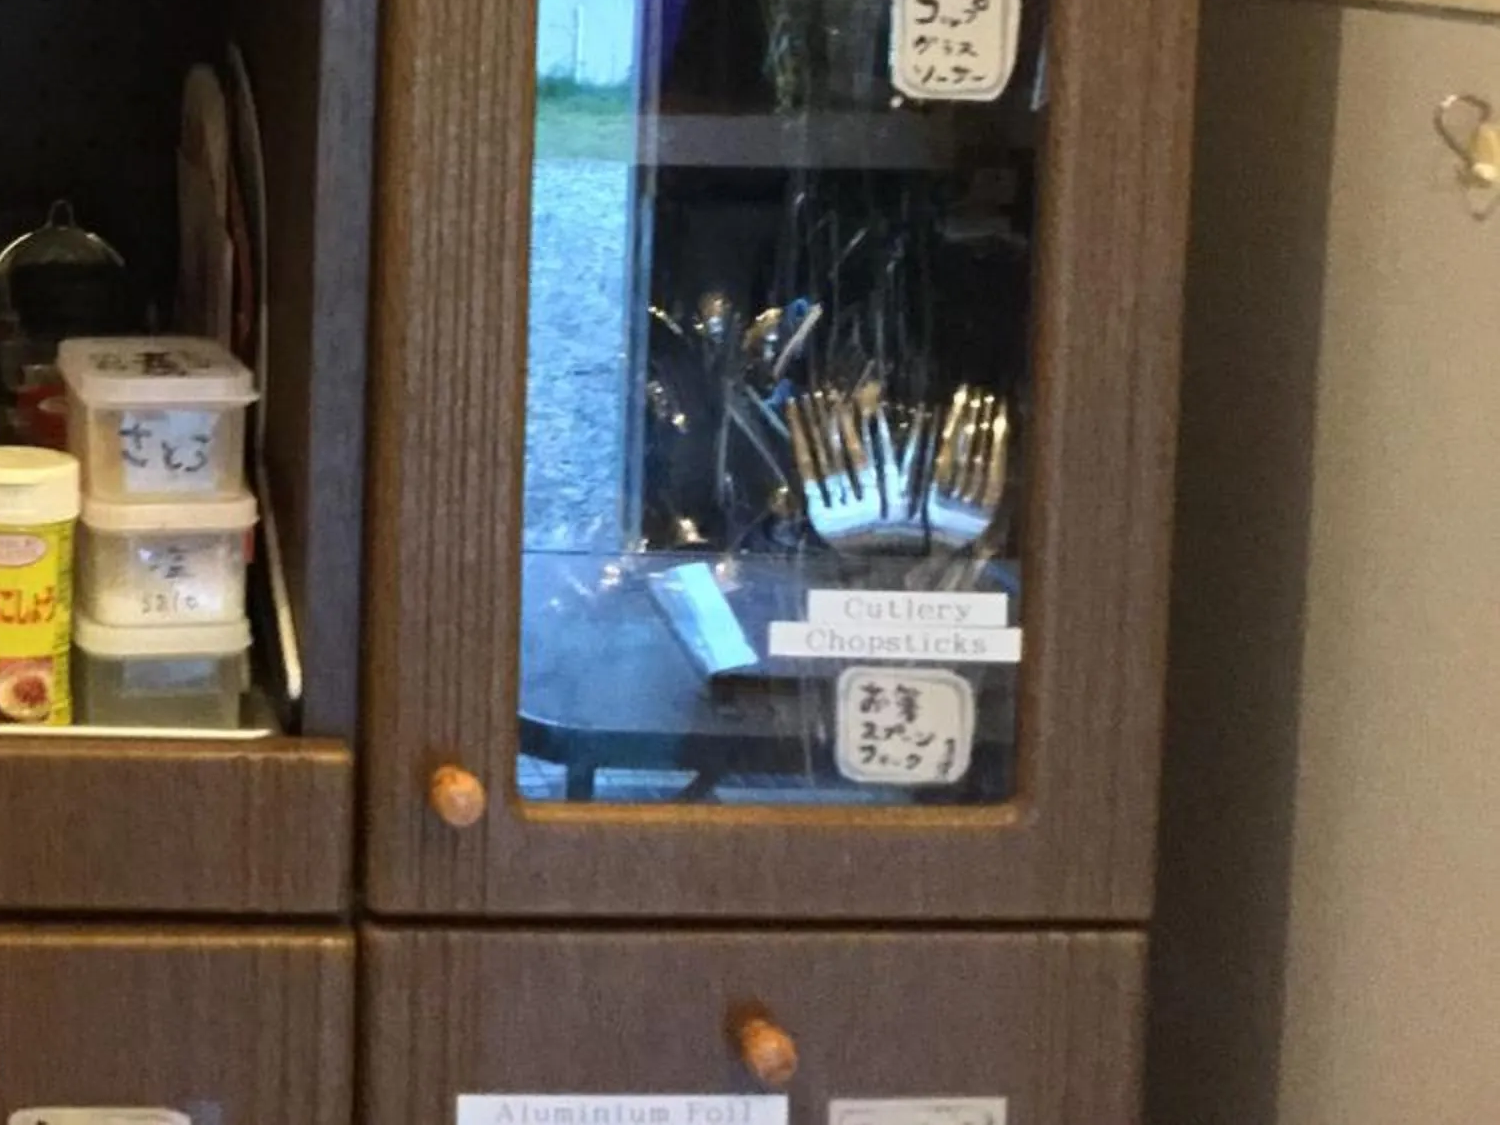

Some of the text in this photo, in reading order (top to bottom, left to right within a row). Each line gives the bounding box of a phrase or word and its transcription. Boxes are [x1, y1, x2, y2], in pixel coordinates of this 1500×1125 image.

[842, 595, 973, 622] Cutlery
[804, 628, 988, 656] Chopsticks
[495, 1100, 752, 1124] Aluminium Foil
